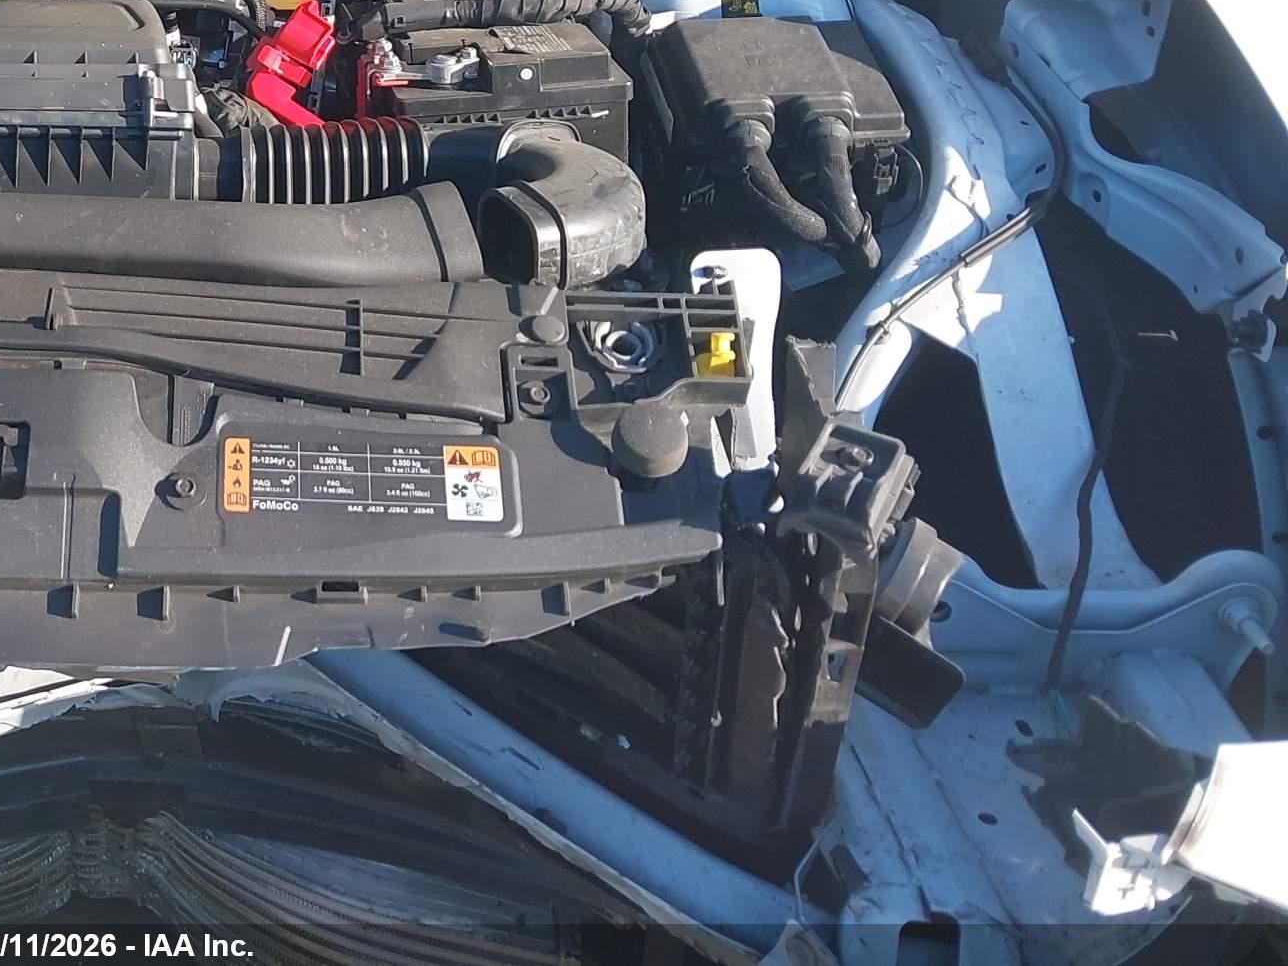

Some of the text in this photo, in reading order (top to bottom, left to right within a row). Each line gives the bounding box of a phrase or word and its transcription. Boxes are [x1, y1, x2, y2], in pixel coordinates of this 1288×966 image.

[252, 456, 286, 466] R-1234yf
[338, 457, 348, 466] kg
[412, 459, 421, 468] kg
[252, 479, 271, 487] PAG
[400, 482, 415, 490] PAG
[252, 499, 299, 511] FoMoCo
